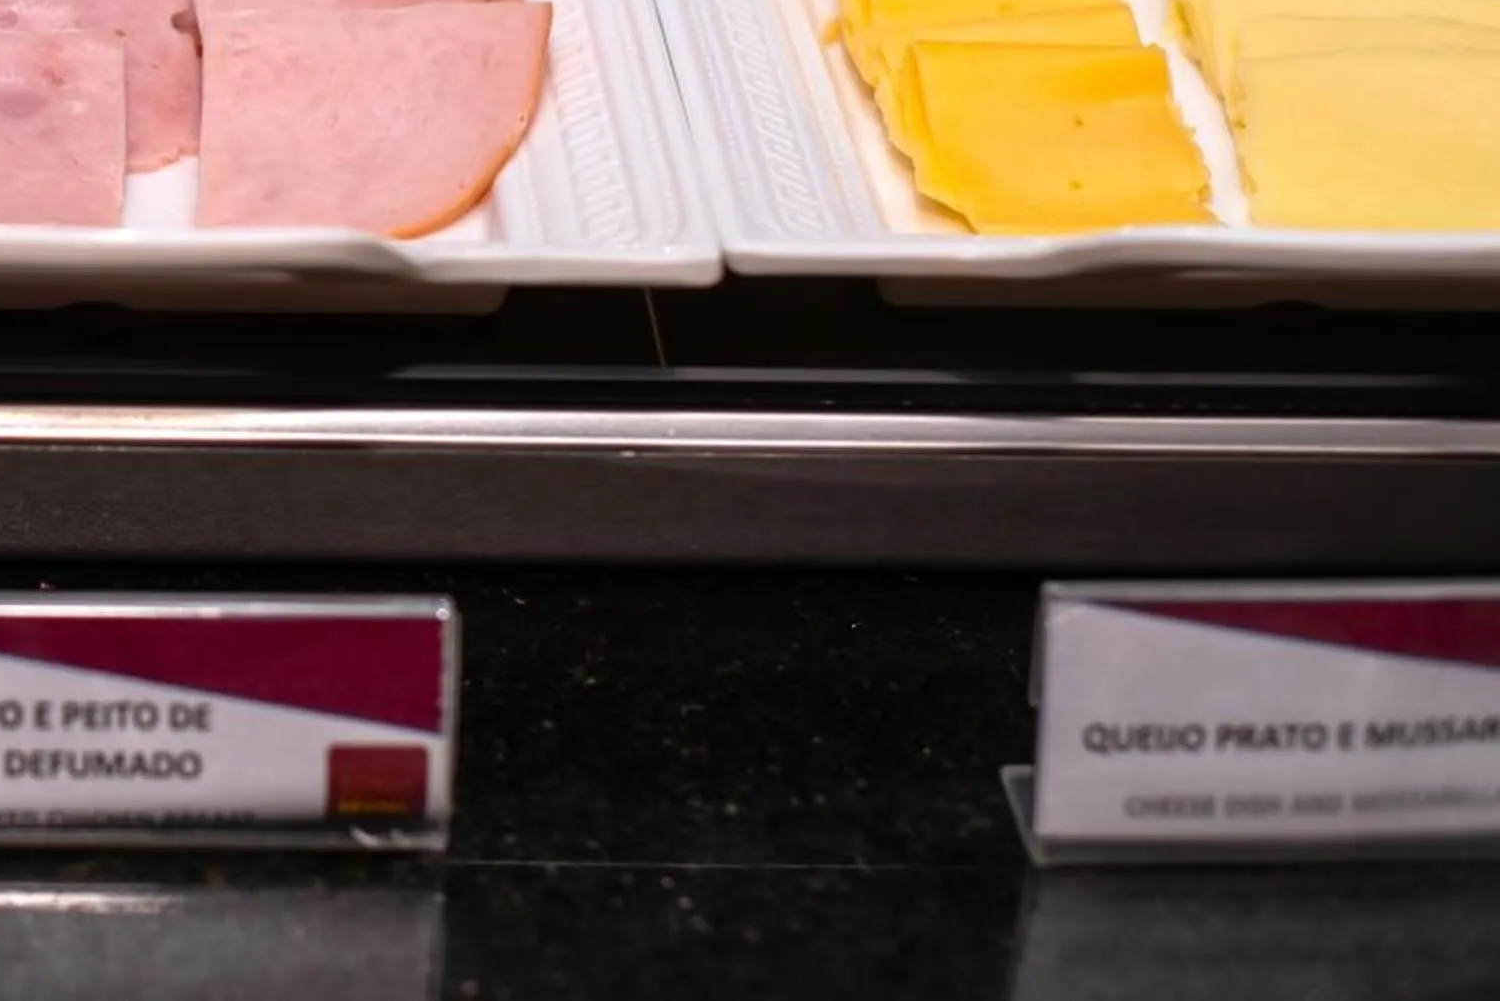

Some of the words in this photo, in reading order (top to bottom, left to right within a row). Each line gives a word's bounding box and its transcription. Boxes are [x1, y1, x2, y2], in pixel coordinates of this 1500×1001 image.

[32, 700, 54, 731] E
[61, 701, 159, 732] PEITO
[168, 701, 213, 733] DE
[1081, 721, 1208, 754] QUEIJO
[1214, 721, 1328, 753] PRATO
[1336, 720, 1357, 750] E
[4, 748, 204, 781] DEFUMADO
